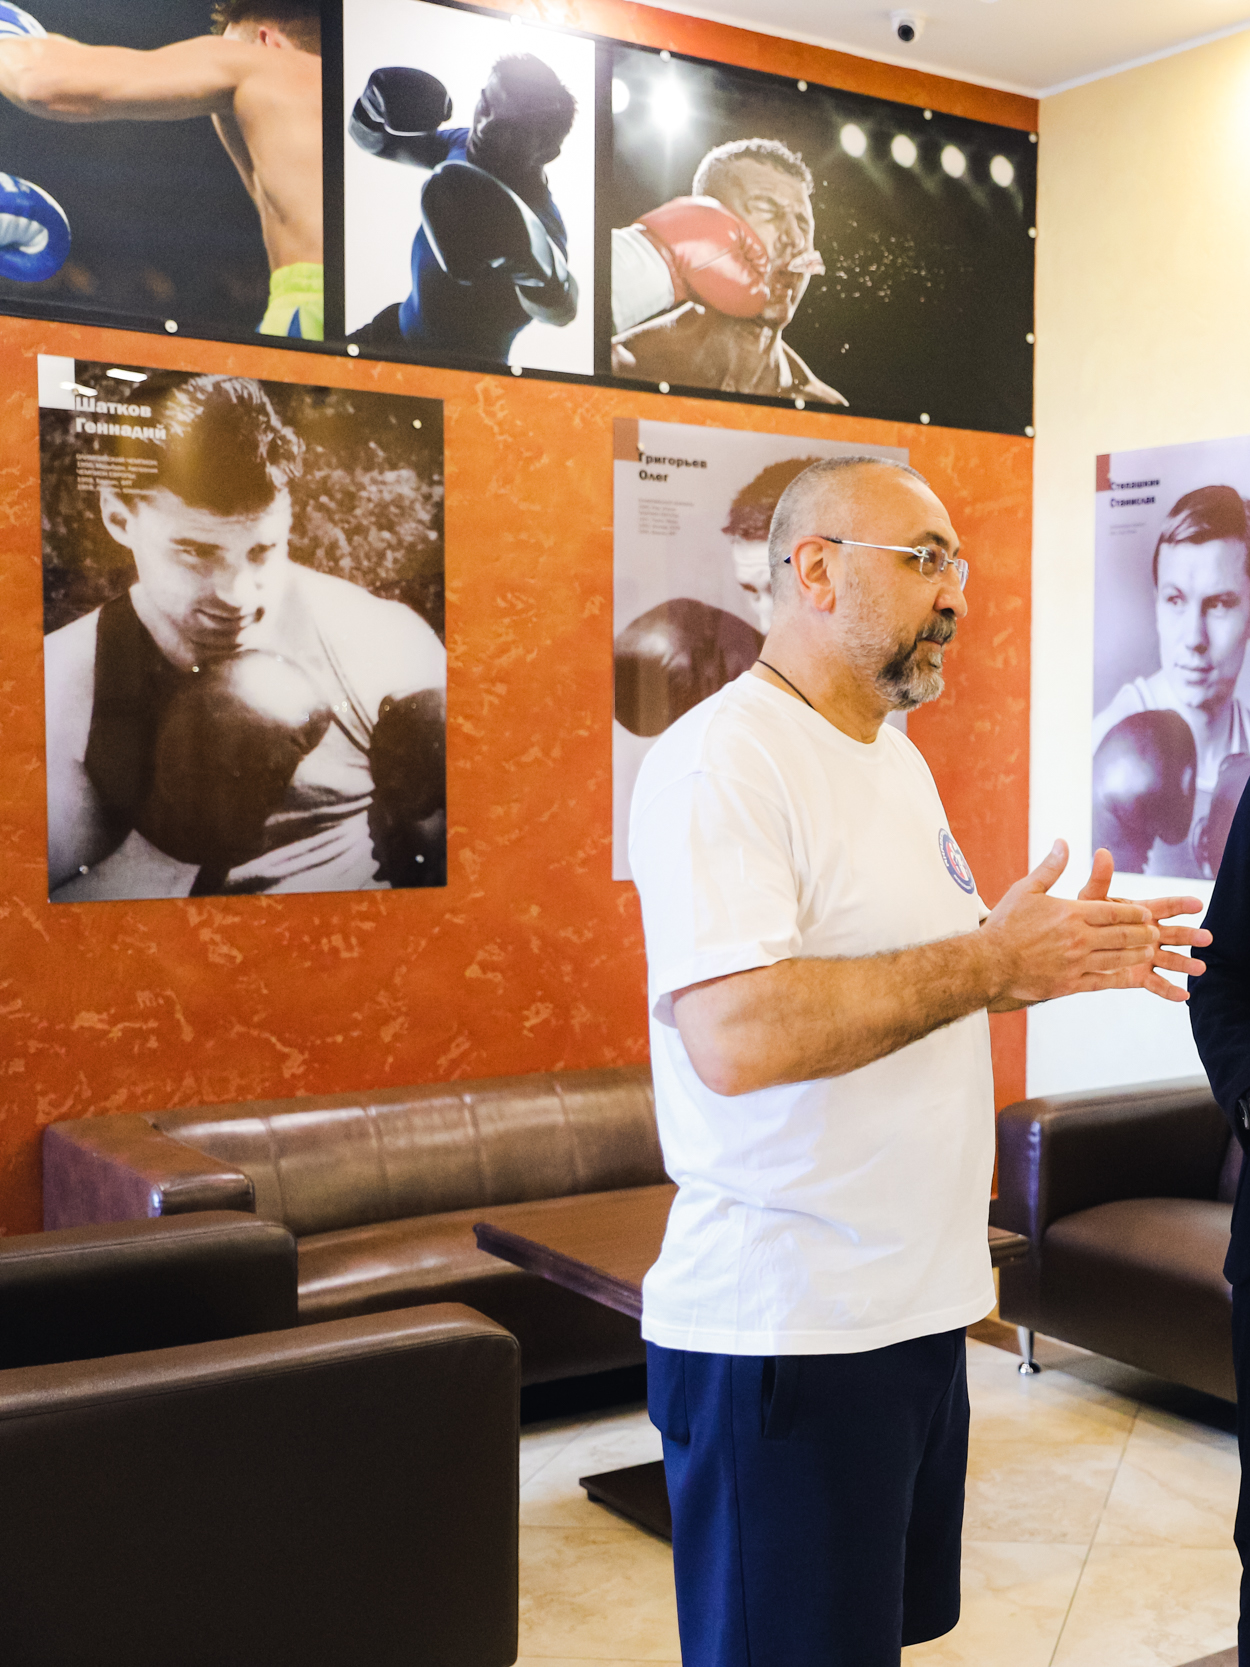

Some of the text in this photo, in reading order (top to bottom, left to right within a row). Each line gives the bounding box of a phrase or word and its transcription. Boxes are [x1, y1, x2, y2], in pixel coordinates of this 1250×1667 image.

[75, 396, 152, 418] Шатков
[75, 417, 167, 440] Геннадий
[638, 452, 708, 469] Григорьев
[639, 470, 669, 482] Олег
[1111, 496, 1156, 508] Станислав
